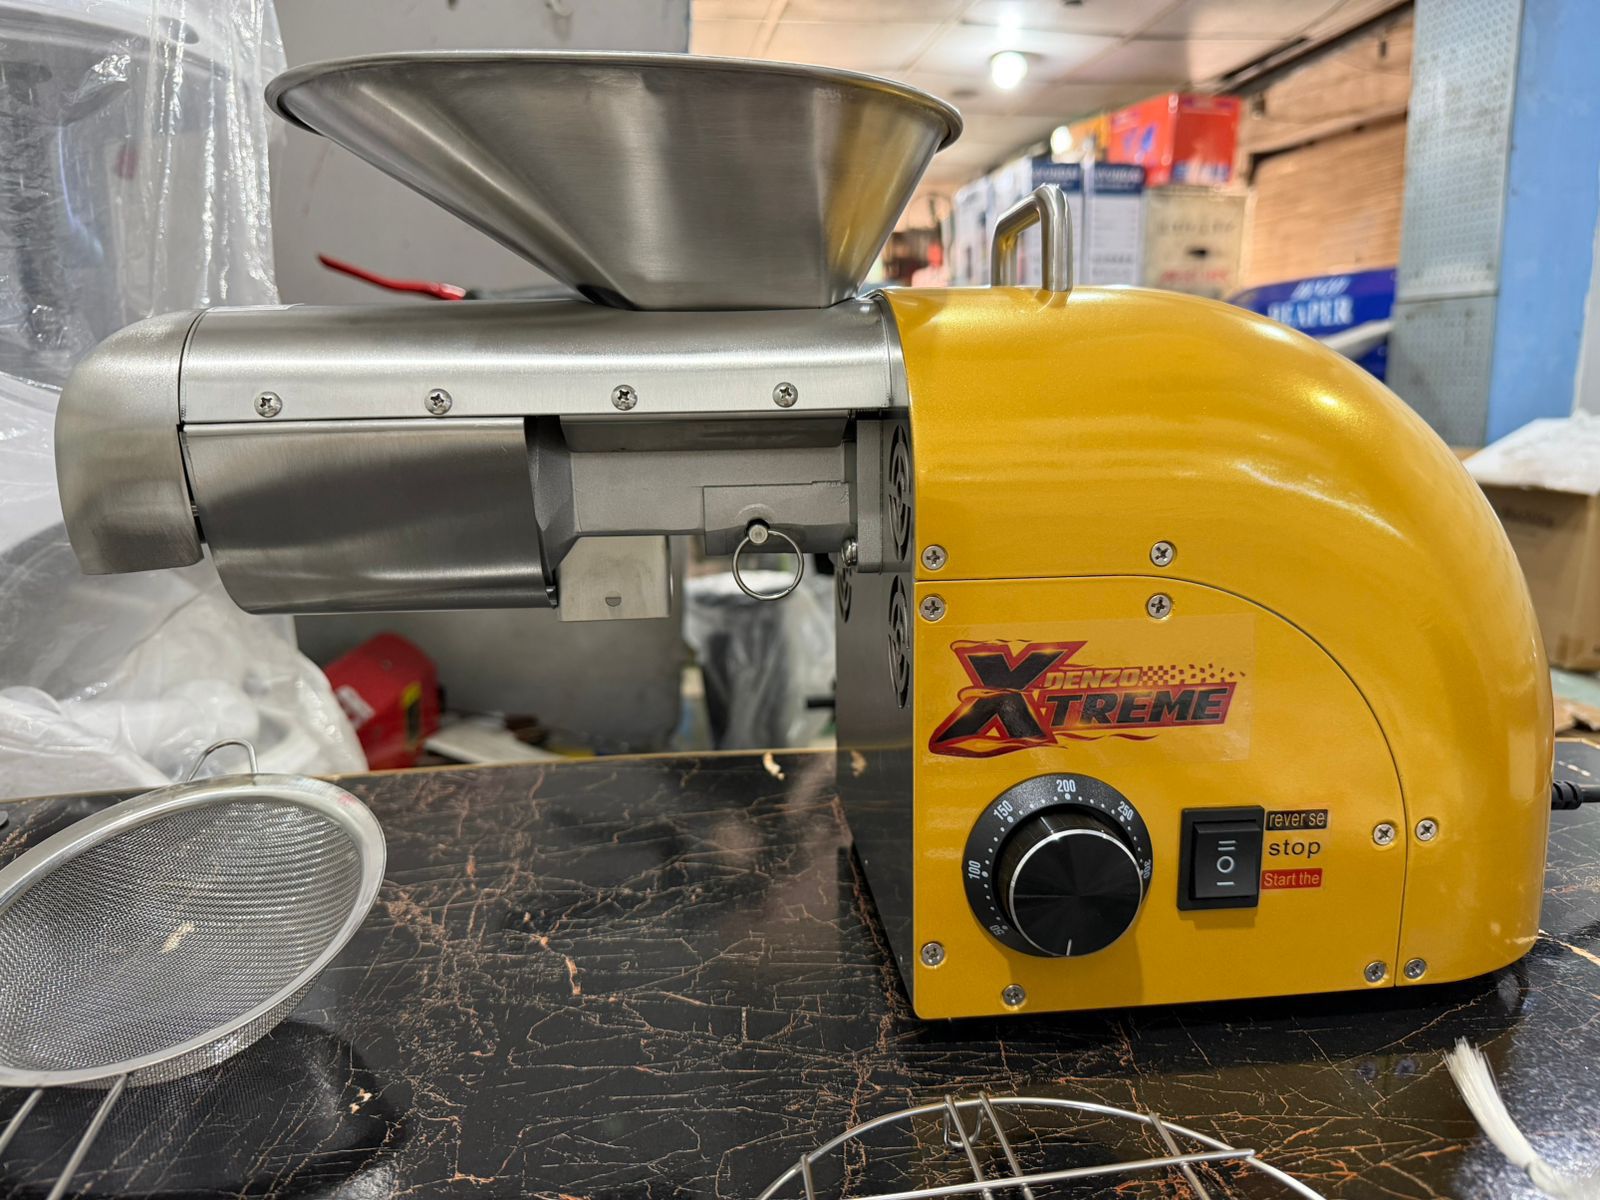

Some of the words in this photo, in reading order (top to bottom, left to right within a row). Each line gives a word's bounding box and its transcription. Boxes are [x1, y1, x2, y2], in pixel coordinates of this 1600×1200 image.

[1044, 668, 1141, 688] DENZO
[1056, 779, 1076, 793] 200
[993, 801, 1014, 821] 150
[1117, 801, 1134, 821] 250
[1268, 839, 1321, 859] stop
[968, 860, 981, 879] 100
[1263, 872, 1296, 887] Start
[1298, 871, 1320, 886] the
[989, 924, 1005, 936] 50
